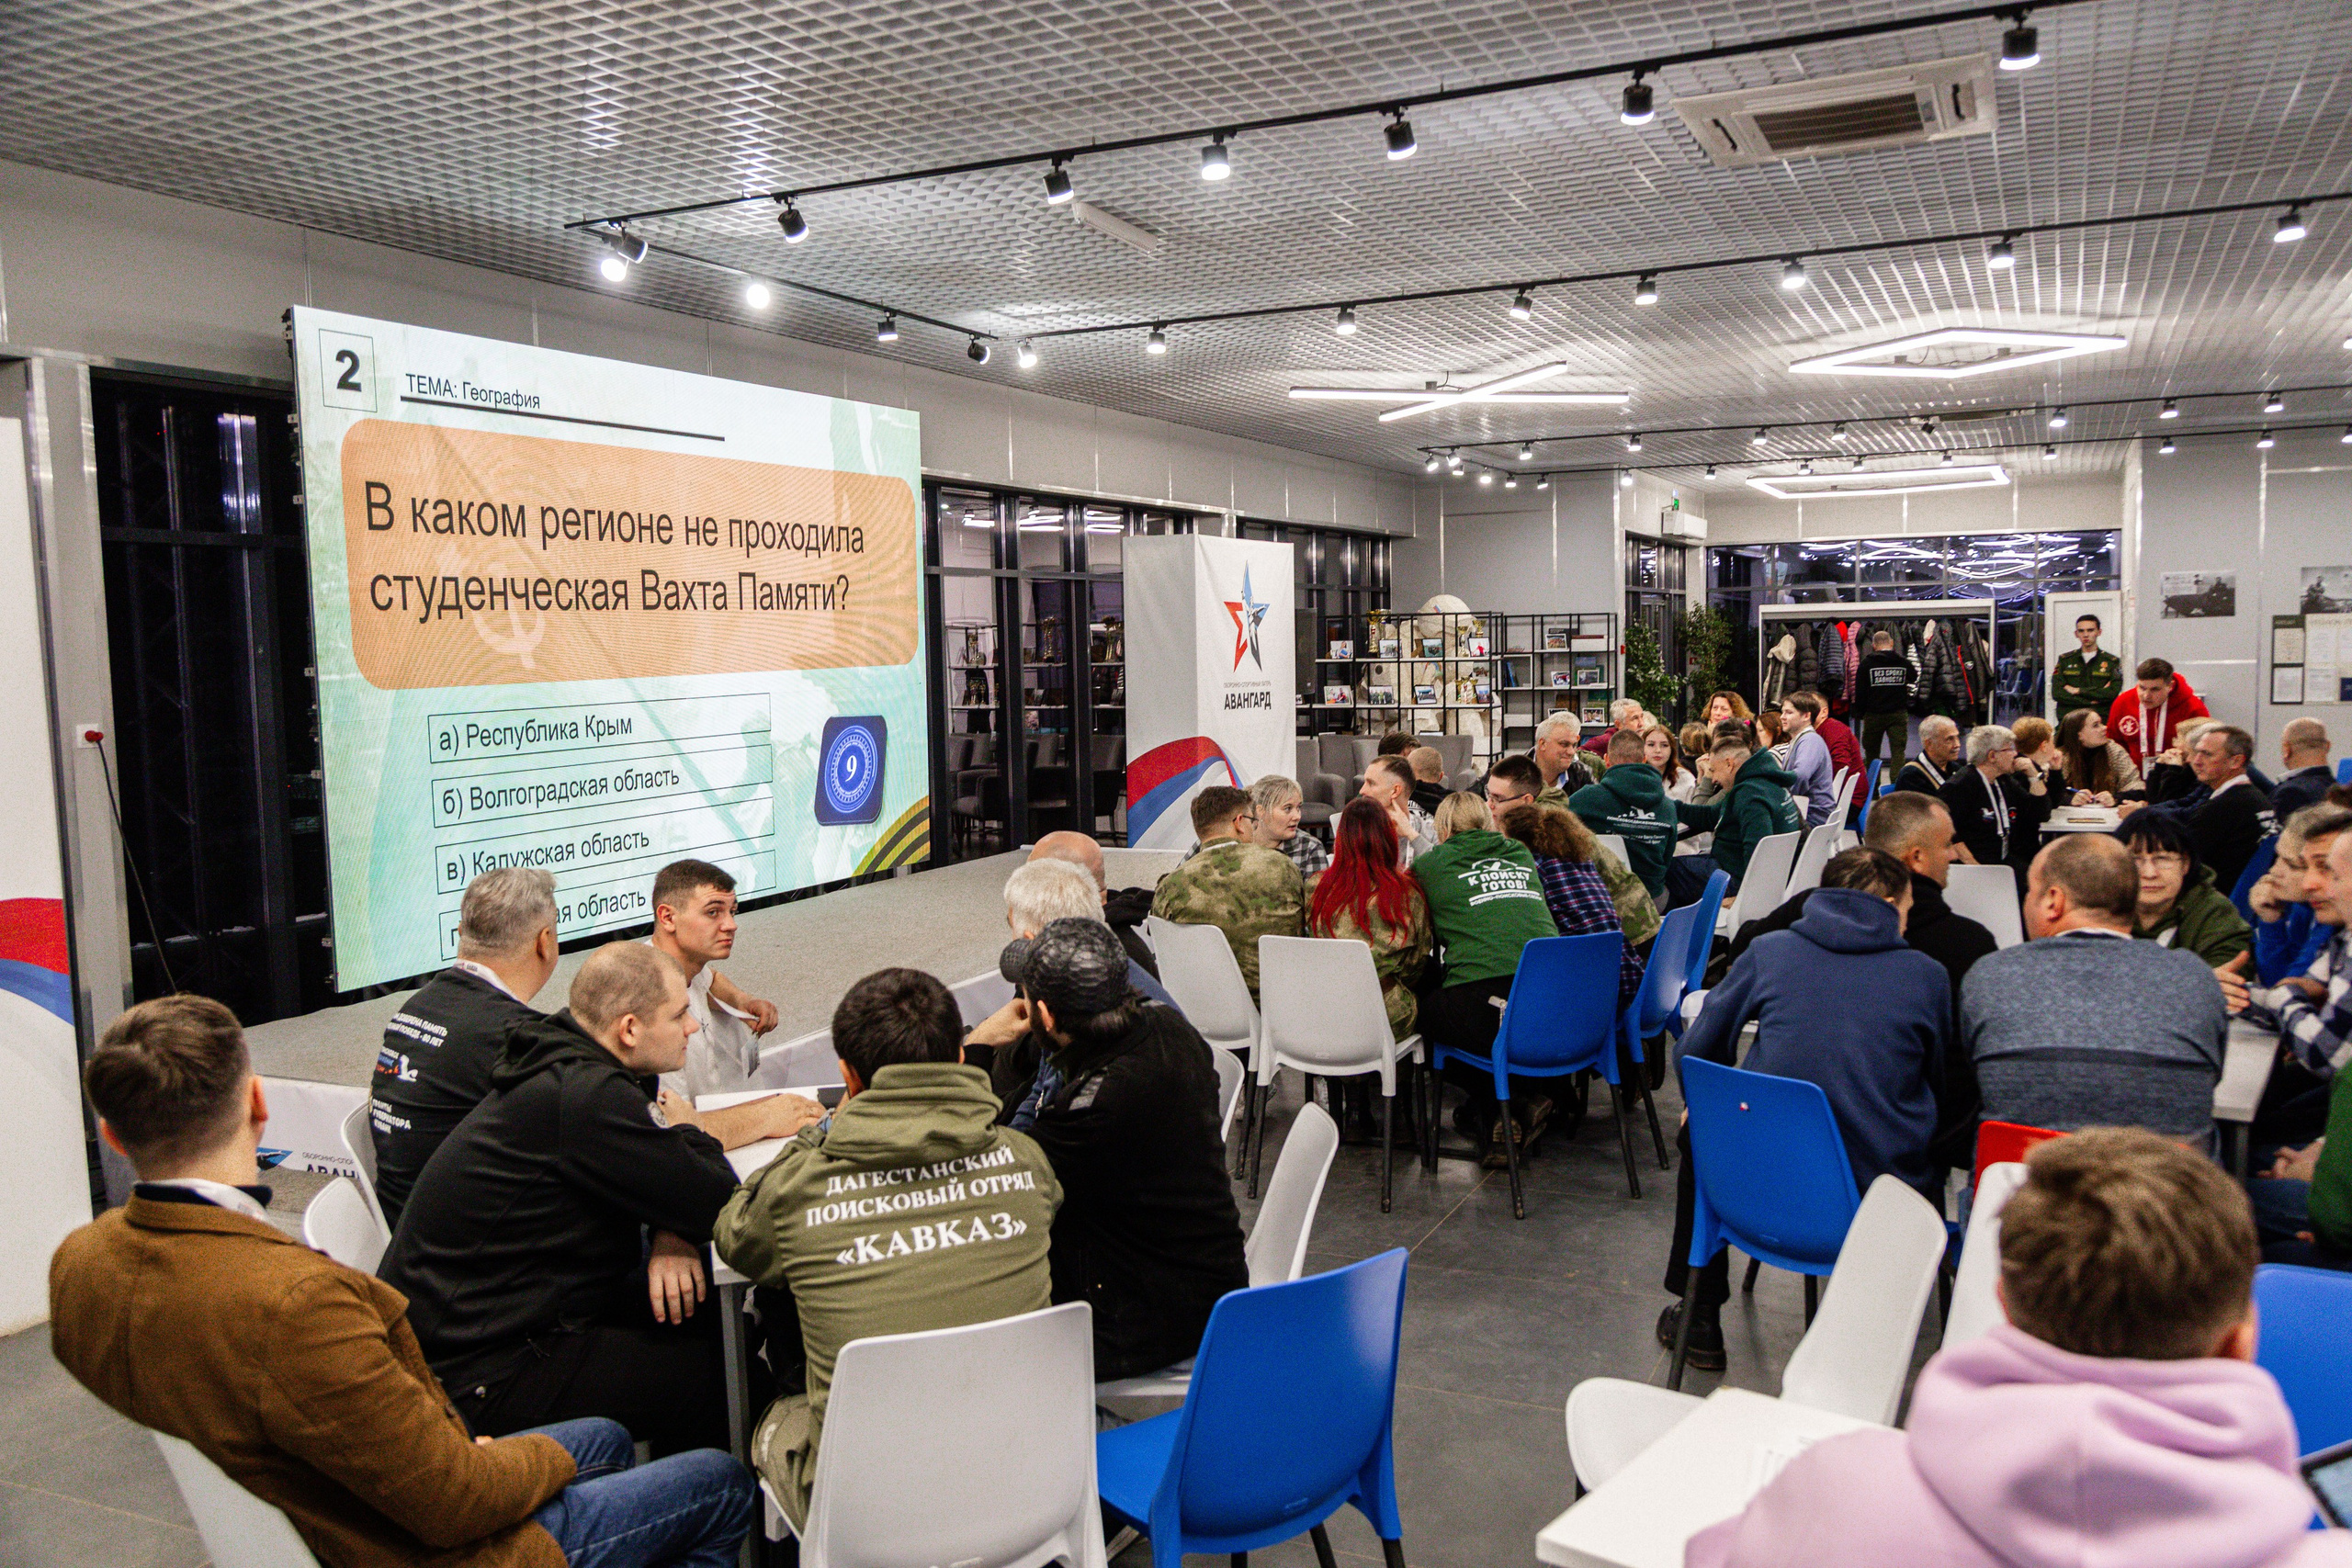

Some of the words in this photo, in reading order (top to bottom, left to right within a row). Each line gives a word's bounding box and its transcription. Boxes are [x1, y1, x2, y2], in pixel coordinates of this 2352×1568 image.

[335, 349, 363, 393] 2
[406, 372, 458, 400] ТЕМА:
[462, 379, 540, 410] География
[364, 480, 395, 532] В
[411, 493, 526, 538] каком
[540, 506, 673, 555] регионе
[684, 512, 719, 548] не
[728, 518, 865, 559] проходила
[369, 572, 629, 623] студенческая
[640, 569, 729, 612] Вахта
[738, 572, 850, 612] Памяти?
[1224, 691, 1272, 711] АВАНГАРД
[438, 726, 460, 757] а)
[466, 717, 580, 751] Республика
[584, 714, 633, 742] Крым
[844, 755, 858, 783] 9
[443, 787, 464, 821] б)
[469, 776, 610, 812] Волгоградская
[614, 764, 680, 794] область
[447, 853, 466, 886] в)
[581, 829, 650, 859] область
[1467, 875, 1479, 886] К
[1479, 871, 1530, 883] ПОИСКУ
[577, 890, 647, 921] область
[1481, 879, 1528, 893] ГОТОВ!
[421, 1020, 448, 1038] ПАМЯТЬ
[429, 1036, 445, 1048] ЛЕТ
[826, 1144, 1014, 1198] ДАГЕСТАНСКИЙ
[806, 1179, 967, 1228] ПОИСКОВЫЙ
[969, 1170, 1035, 1199] ОТРЯД
[835, 1211, 1028, 1266] «КАВКАЗ»
